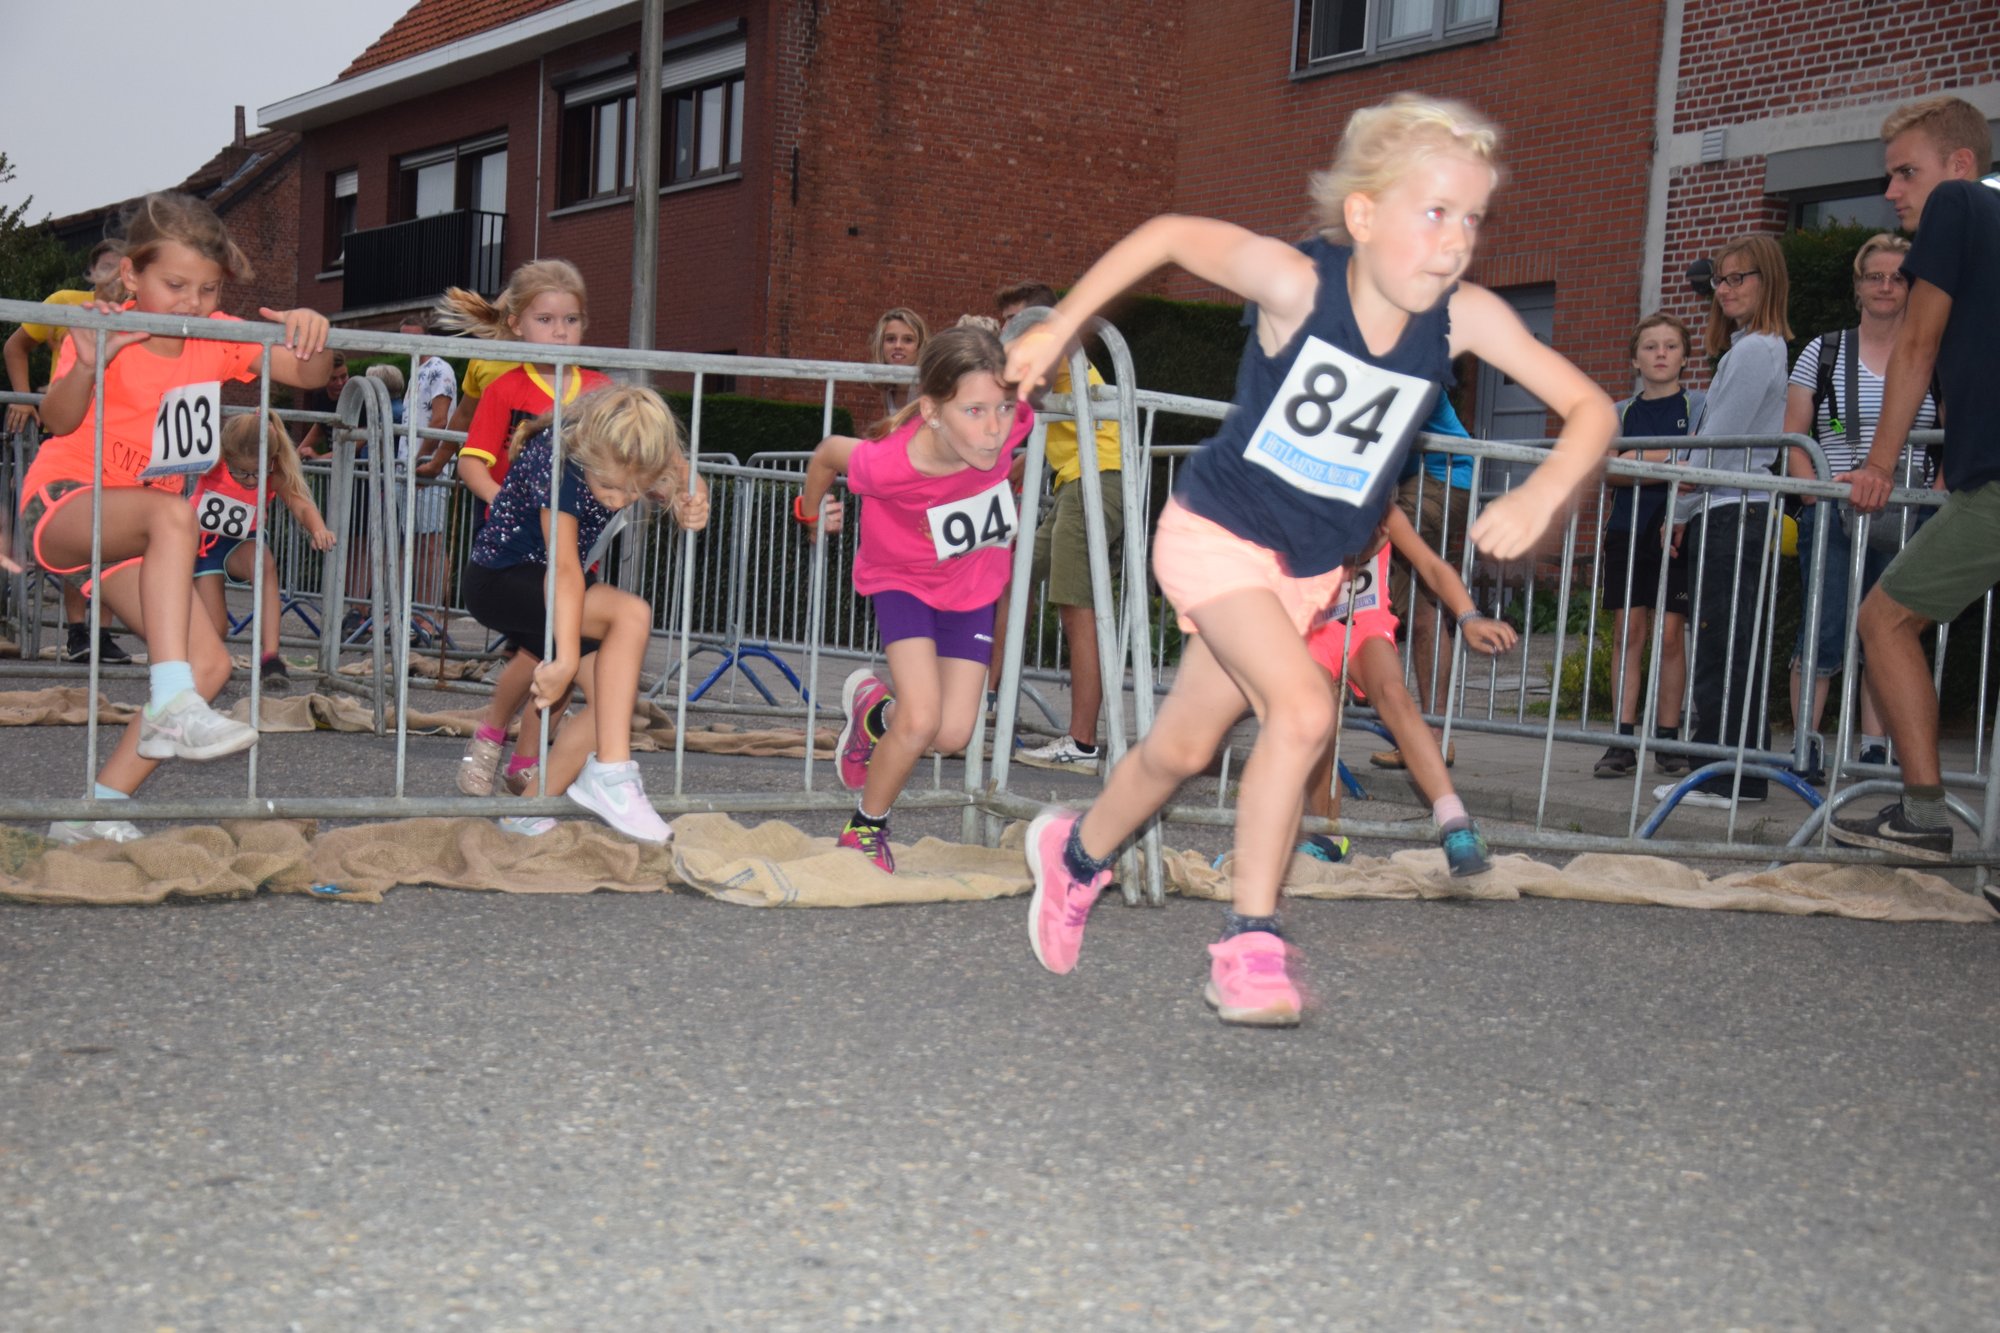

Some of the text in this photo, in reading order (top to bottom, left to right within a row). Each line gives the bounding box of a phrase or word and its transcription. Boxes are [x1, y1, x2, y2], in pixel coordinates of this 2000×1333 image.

[157, 395, 213, 460] 103
[1284, 361, 1400, 455] 84
[1262, 433, 1288, 457] HET
[1281, 444, 1328, 480] LAATSTE
[201, 497, 247, 536] 88
[942, 493, 1011, 558] 94
